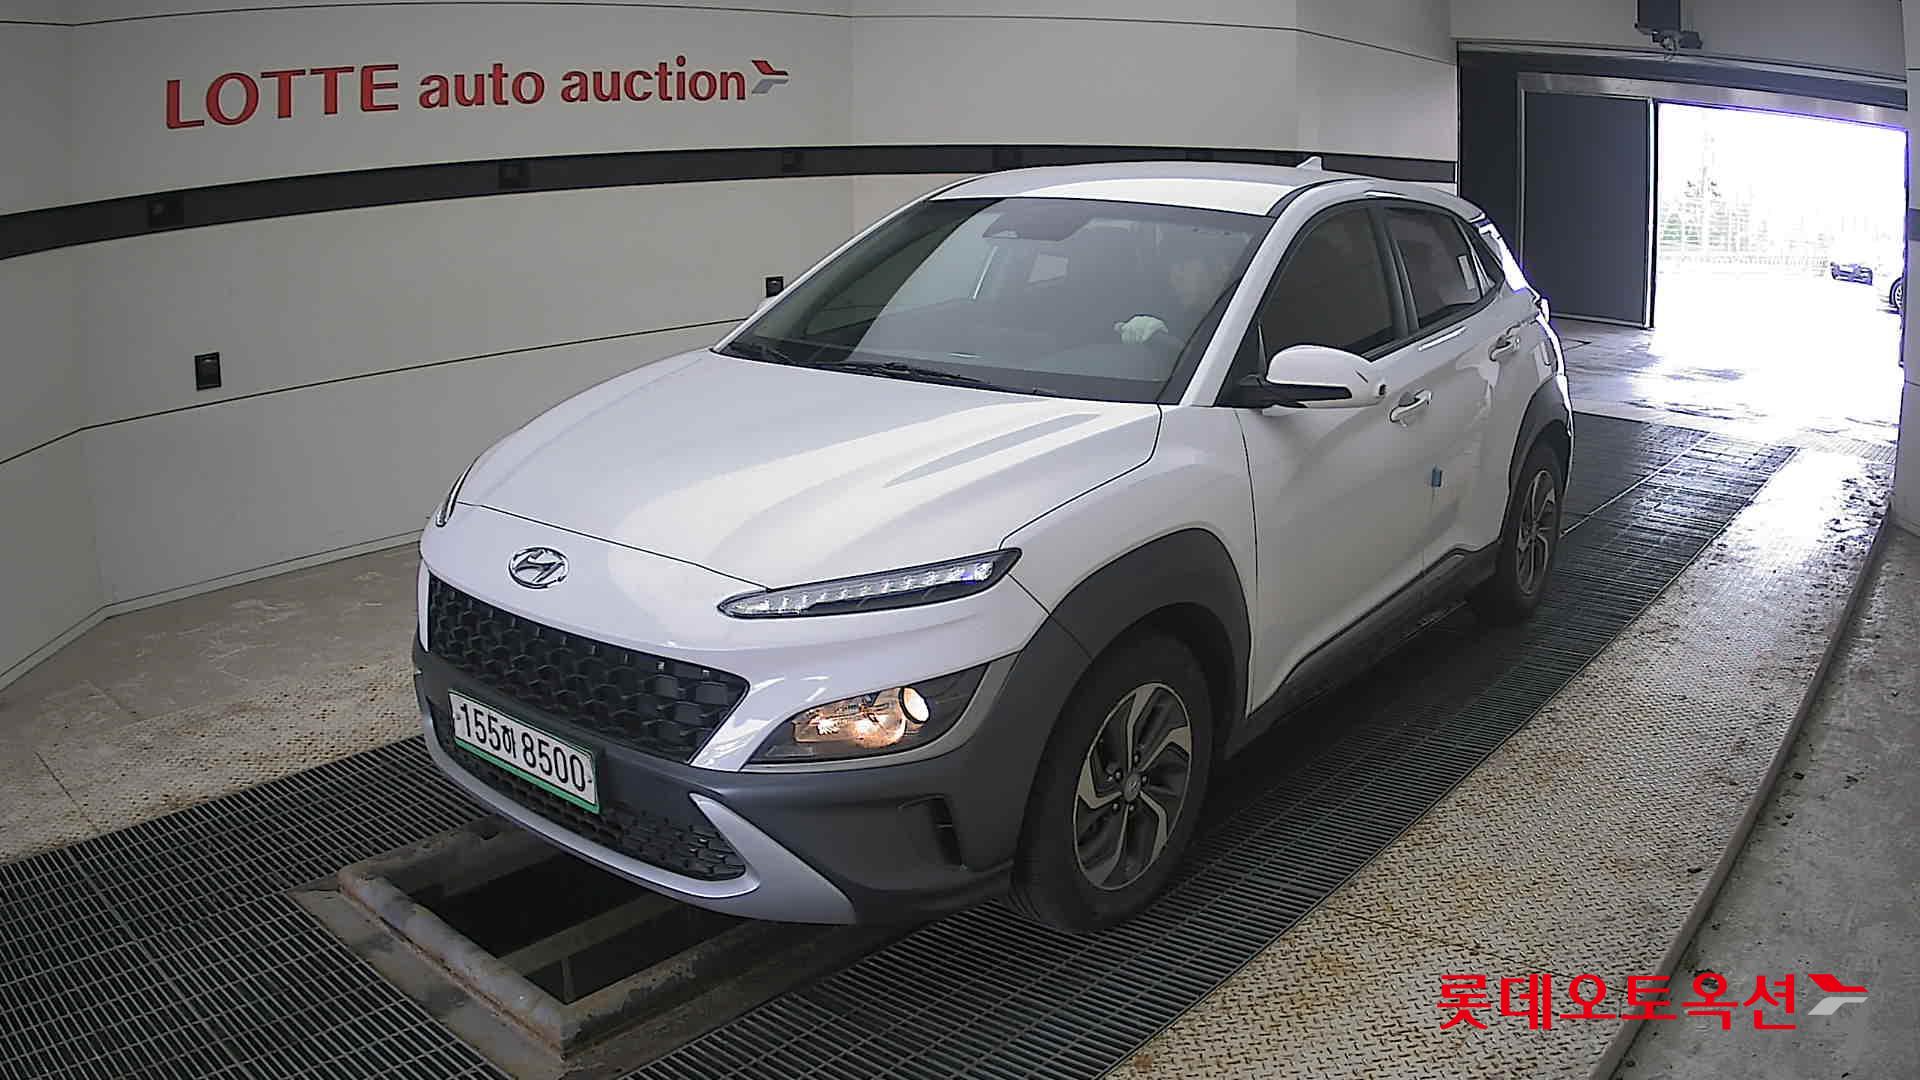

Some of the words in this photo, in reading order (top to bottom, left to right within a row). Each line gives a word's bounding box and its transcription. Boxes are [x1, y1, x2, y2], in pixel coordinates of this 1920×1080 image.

[165, 63, 399, 129] LOTTE
[418, 62, 545, 109] auto
[560, 56, 746, 103] auction
[521, 732, 586, 792] 8500
